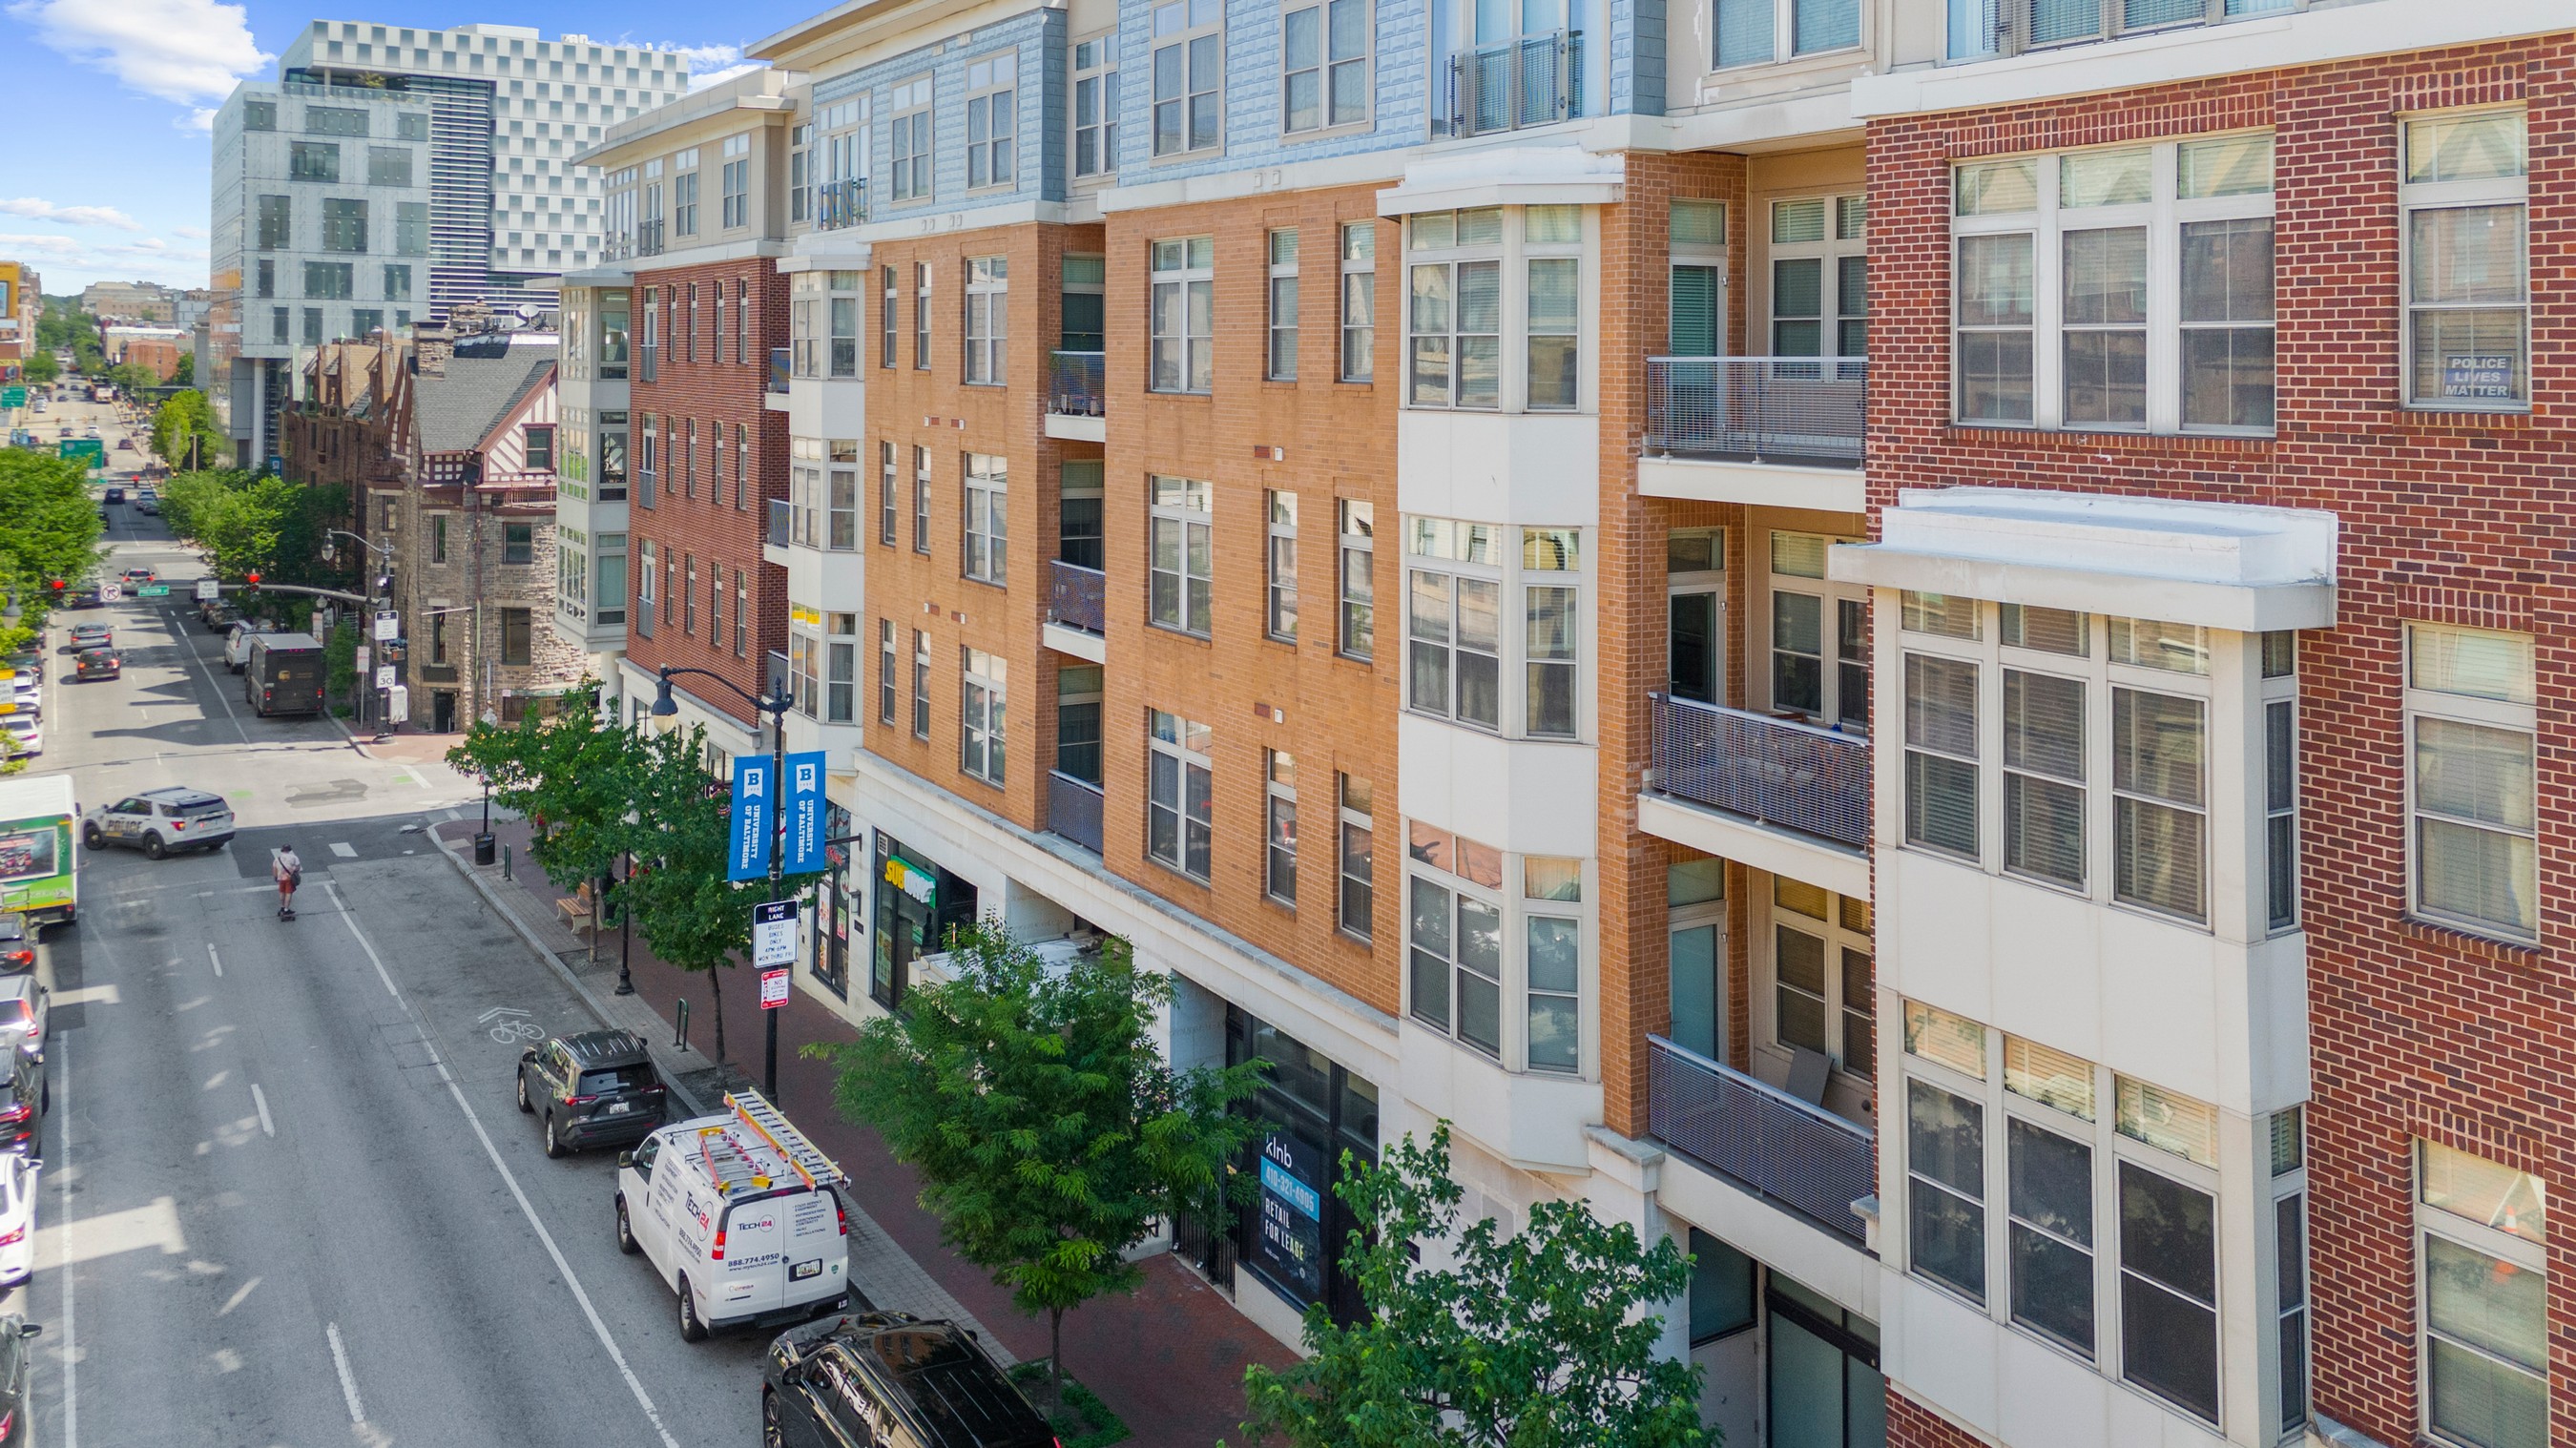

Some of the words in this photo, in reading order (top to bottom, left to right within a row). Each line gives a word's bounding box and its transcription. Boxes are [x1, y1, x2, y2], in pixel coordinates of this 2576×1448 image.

[2451, 358, 2506, 369] POLICE
[2454, 371, 2501, 383] LIVES
[2444, 384, 2507, 396] MATTER
[747, 773, 759, 786] B
[800, 768, 812, 781] B
[744, 805, 752, 817] OF
[799, 800, 806, 812] OF
[107, 818, 143, 833] POLICE
[750, 804, 760, 859] UNIVERSITY
[741, 817, 752, 870] BALTIMORE
[798, 813, 806, 863] BALTIMORE
[1265, 1132, 1293, 1169] klnb
[1265, 1165, 1315, 1213] 410-321-4905
[1265, 1197, 1290, 1229] RETAIL
[1265, 1219, 1279, 1244] FOR
[1281, 1231, 1304, 1261] LEASE
[728, 1252, 779, 1267] 888.774.4950
